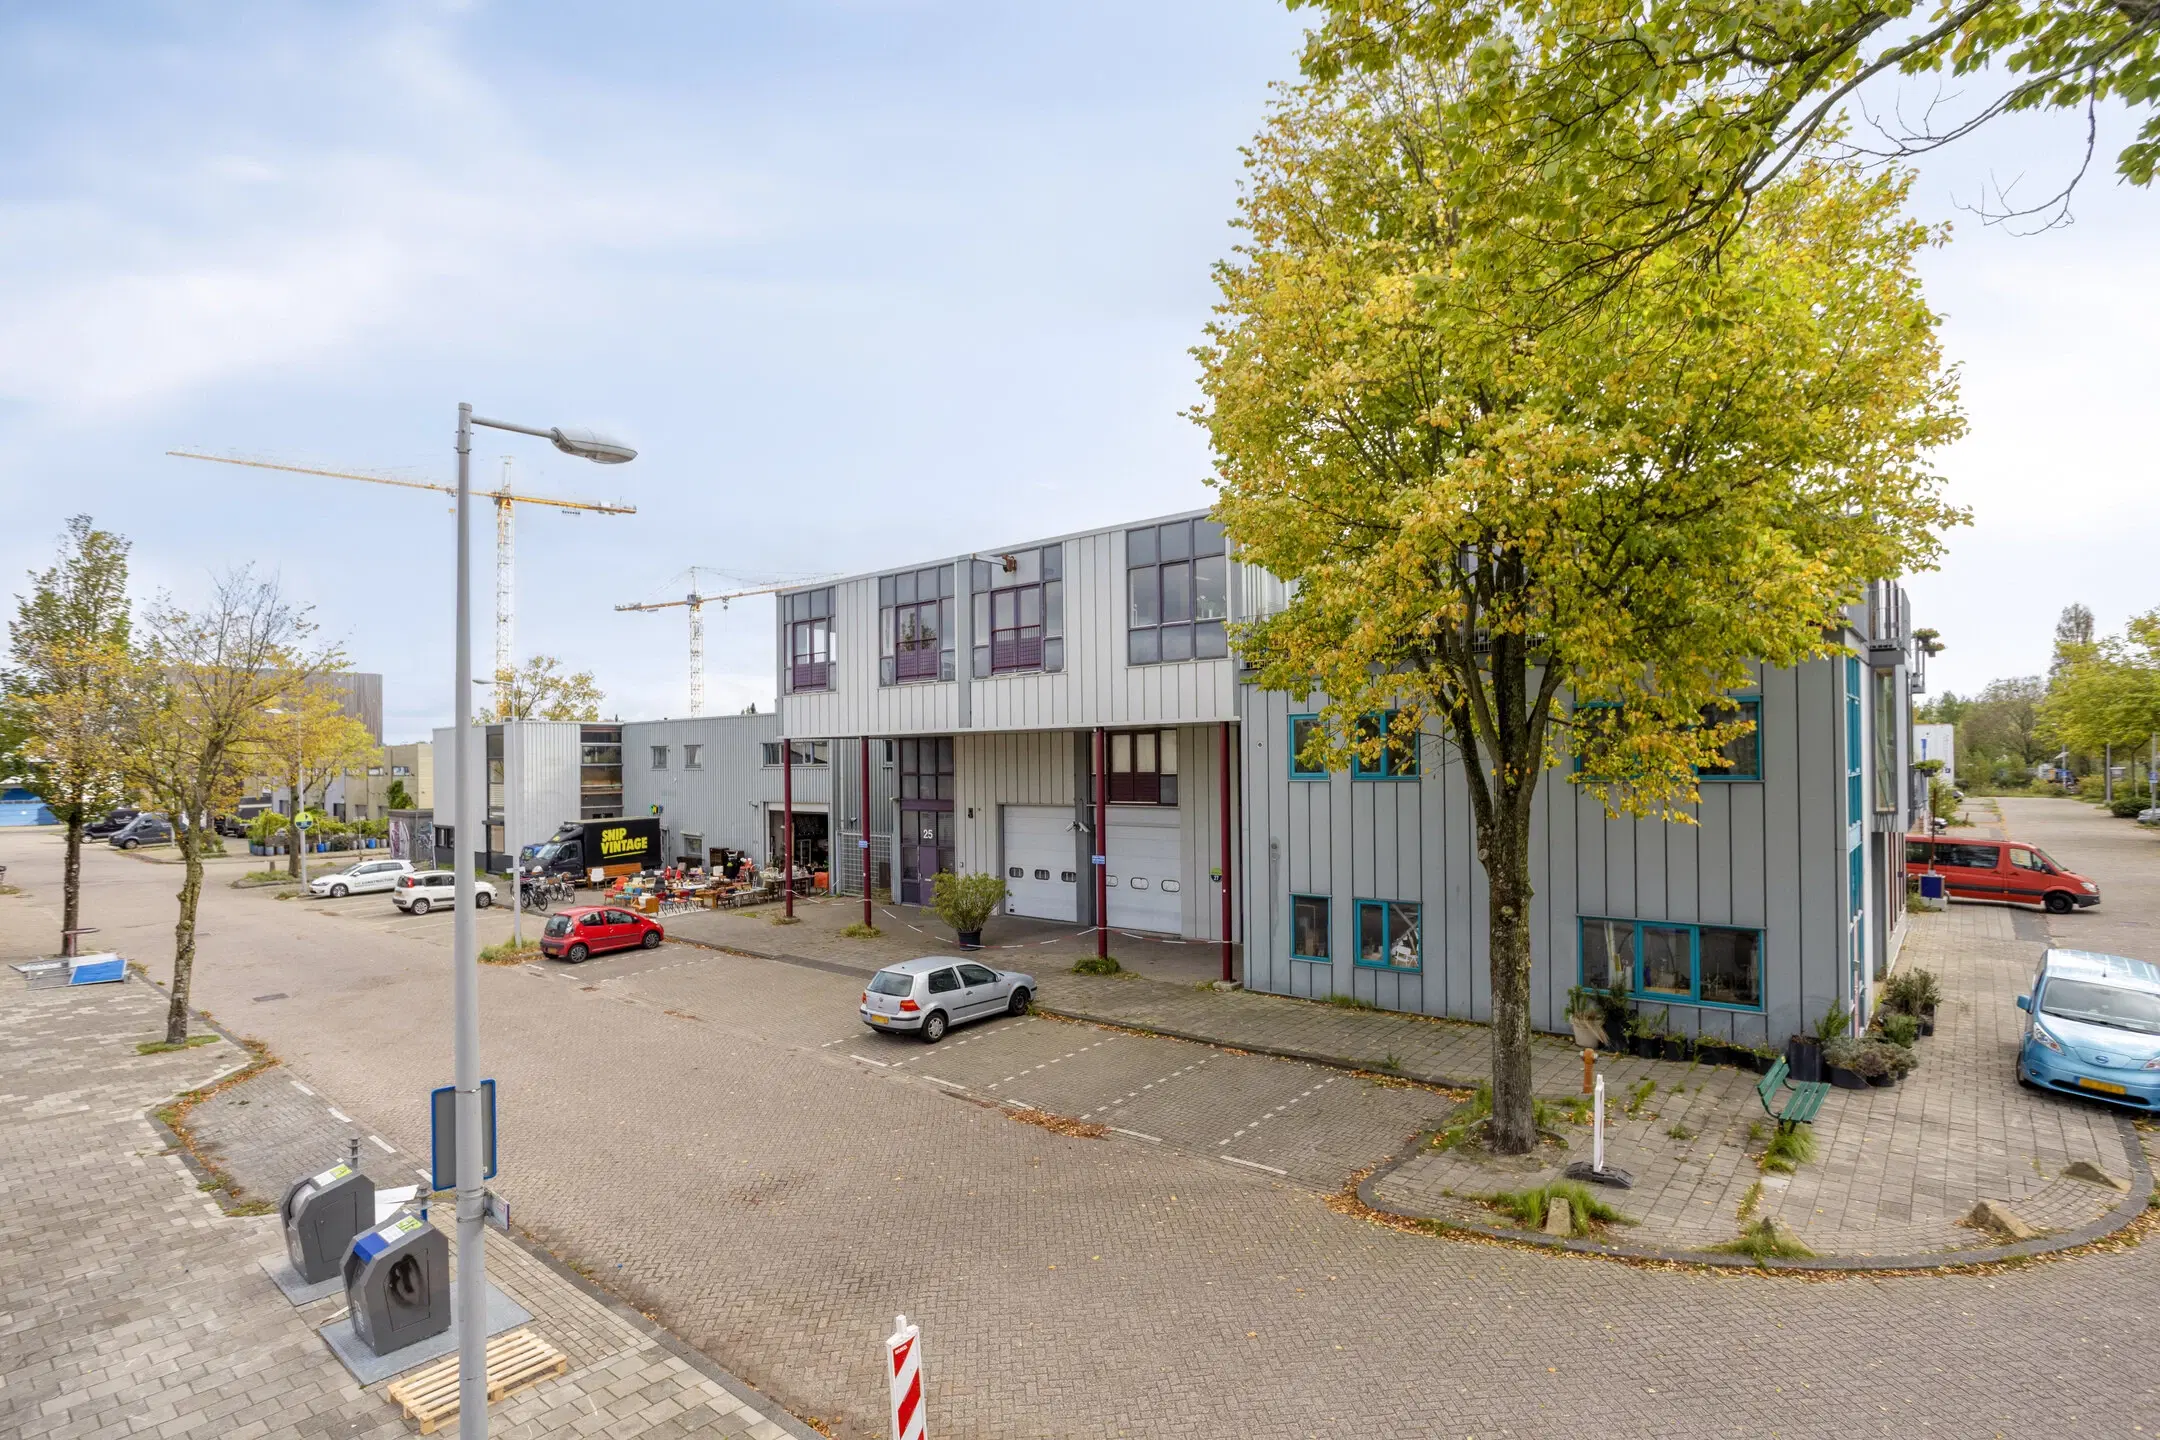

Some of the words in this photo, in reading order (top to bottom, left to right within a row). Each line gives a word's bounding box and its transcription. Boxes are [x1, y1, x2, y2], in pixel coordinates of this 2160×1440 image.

[602, 828, 627, 842] SNIP
[923, 829, 933, 839] 25
[601, 837, 648, 854] VINTAGE
